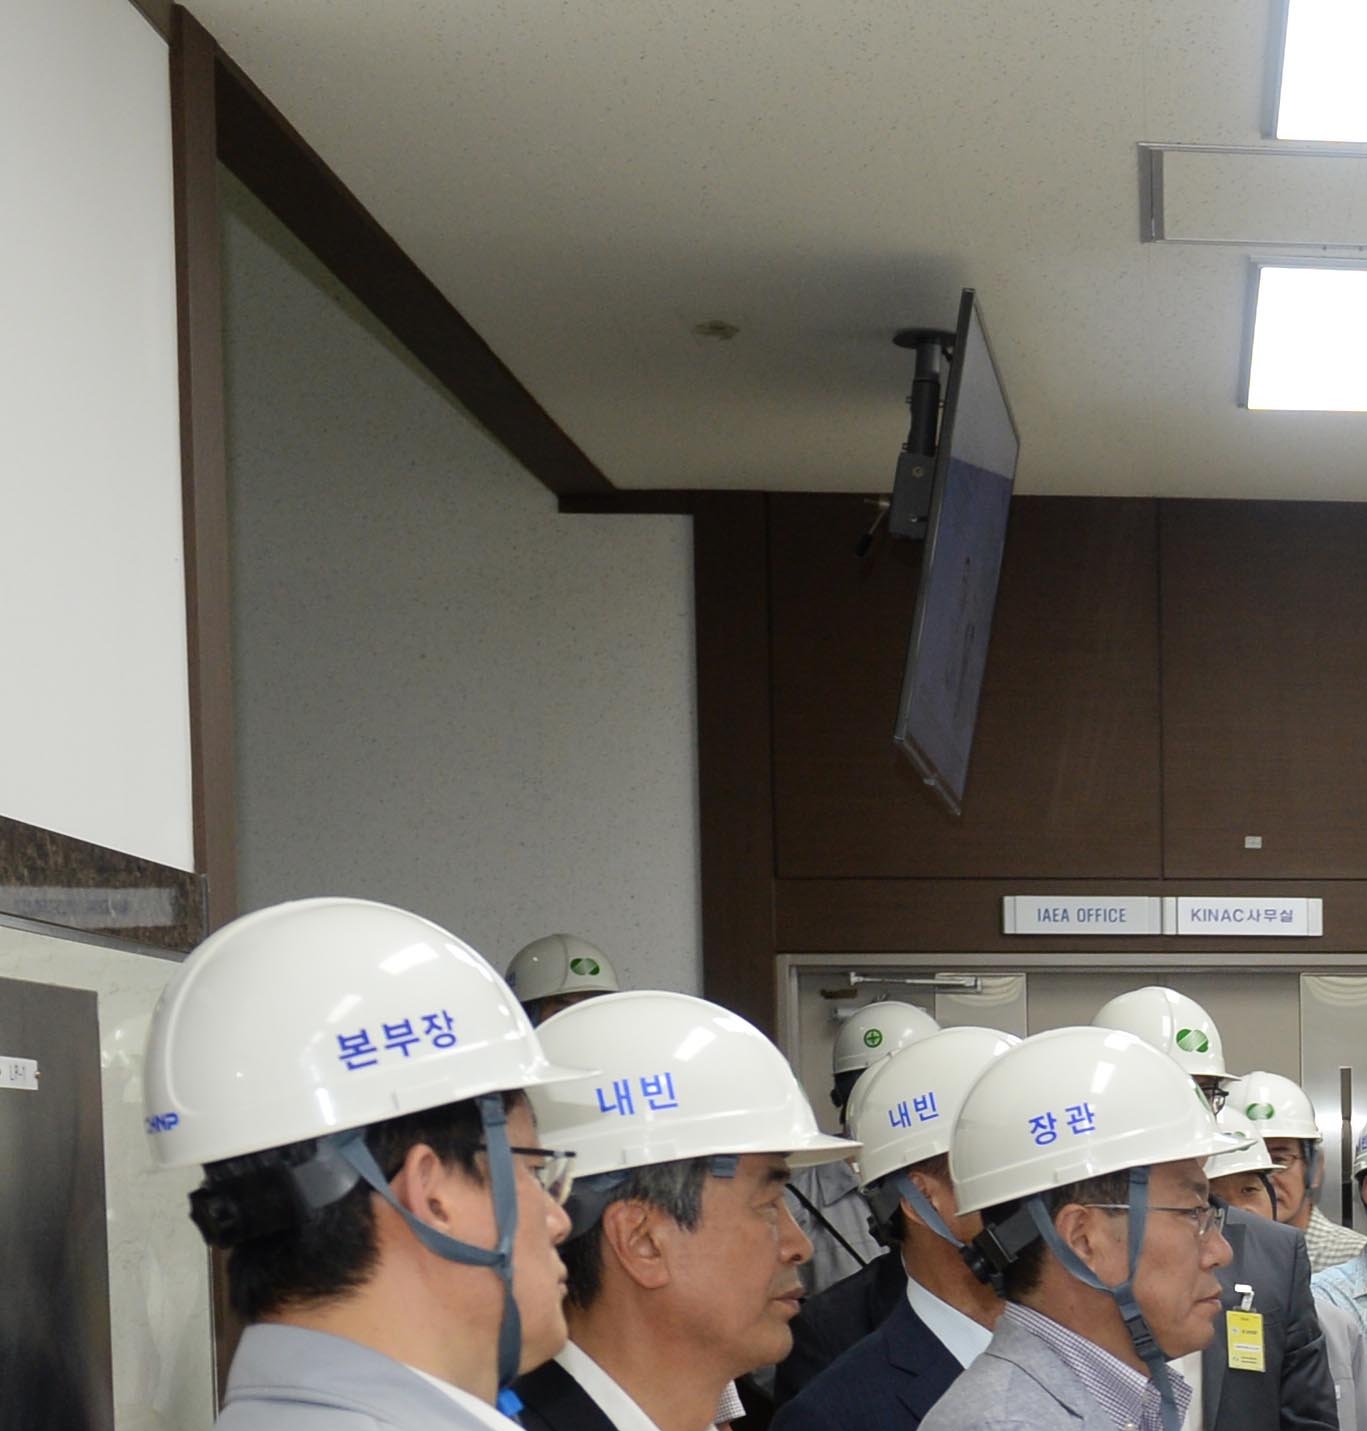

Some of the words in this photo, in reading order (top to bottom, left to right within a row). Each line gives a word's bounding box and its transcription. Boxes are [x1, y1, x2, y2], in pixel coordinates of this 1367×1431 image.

[1036, 906, 1070, 923] IAEA
[1075, 906, 1128, 923] OFFICE
[335, 1009, 458, 1072] 본부장
[595, 1071, 680, 1117] 내빈
[887, 1091, 940, 1129] 내빈
[1028, 1102, 1097, 1147] 장관
